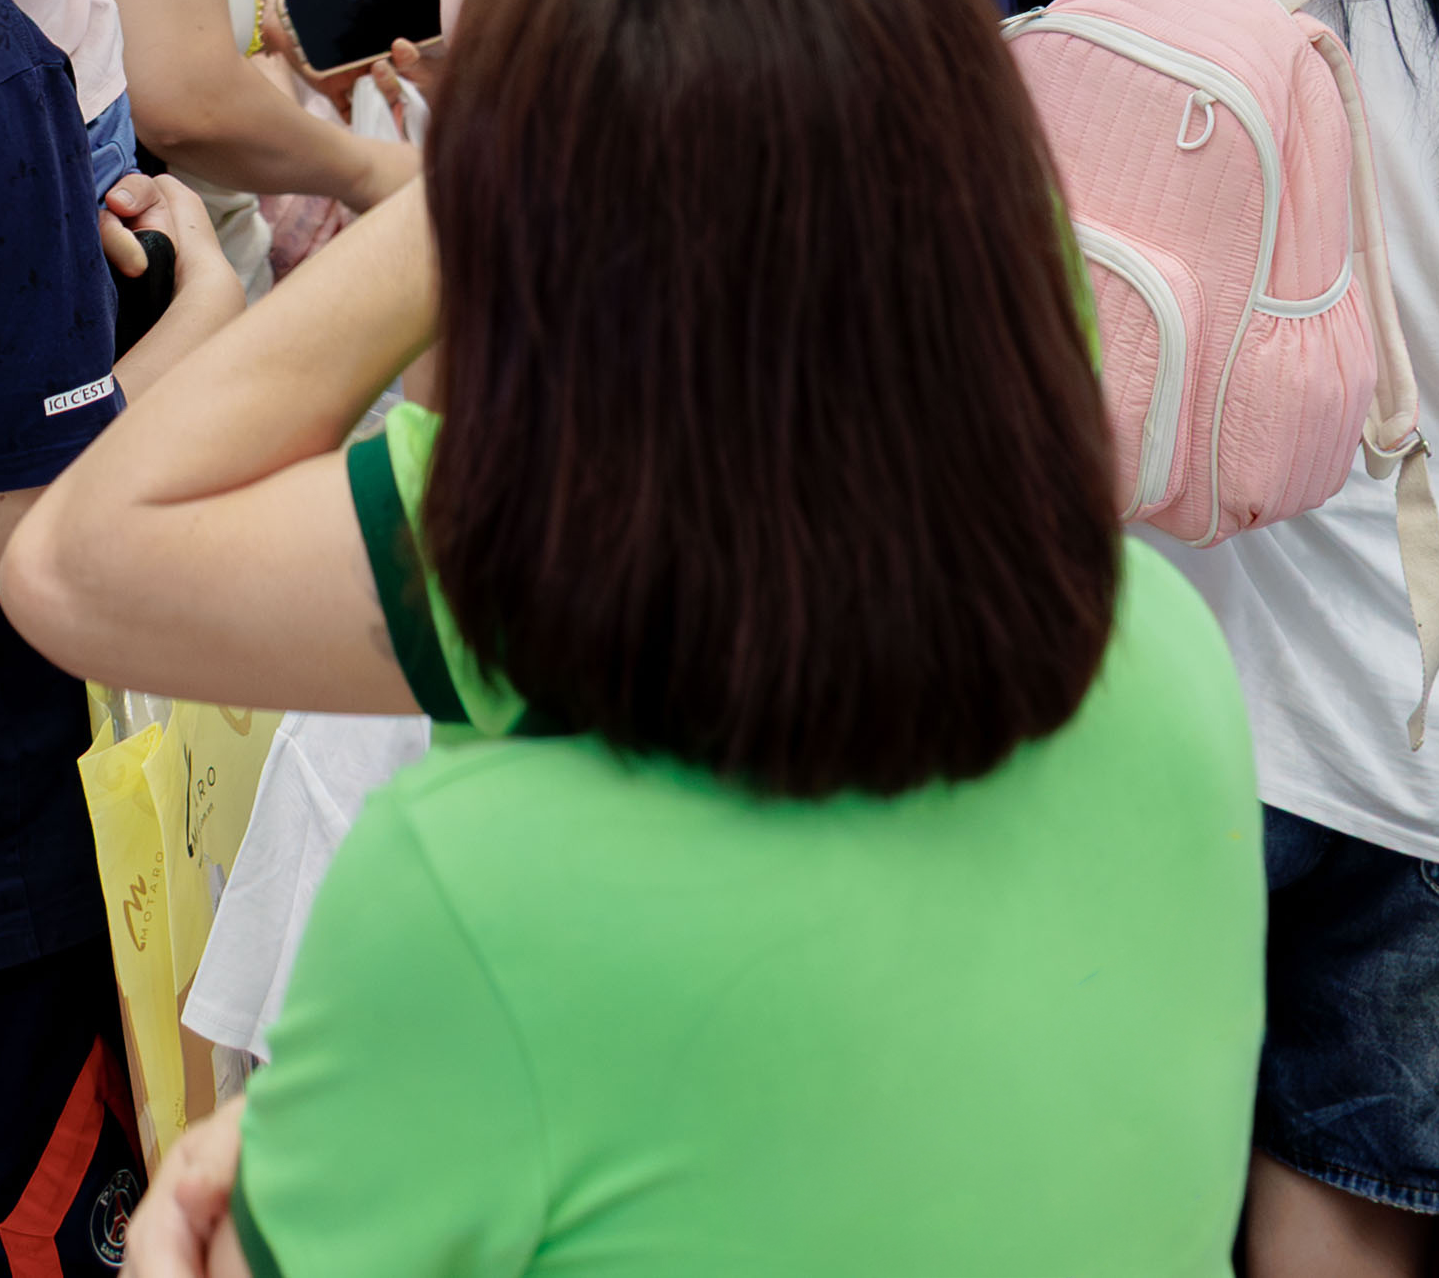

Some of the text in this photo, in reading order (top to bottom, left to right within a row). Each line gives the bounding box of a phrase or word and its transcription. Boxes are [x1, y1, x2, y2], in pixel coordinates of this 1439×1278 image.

[48, 381, 106, 411] ICI C'EST
[139, 851, 164, 944] MOTARO
